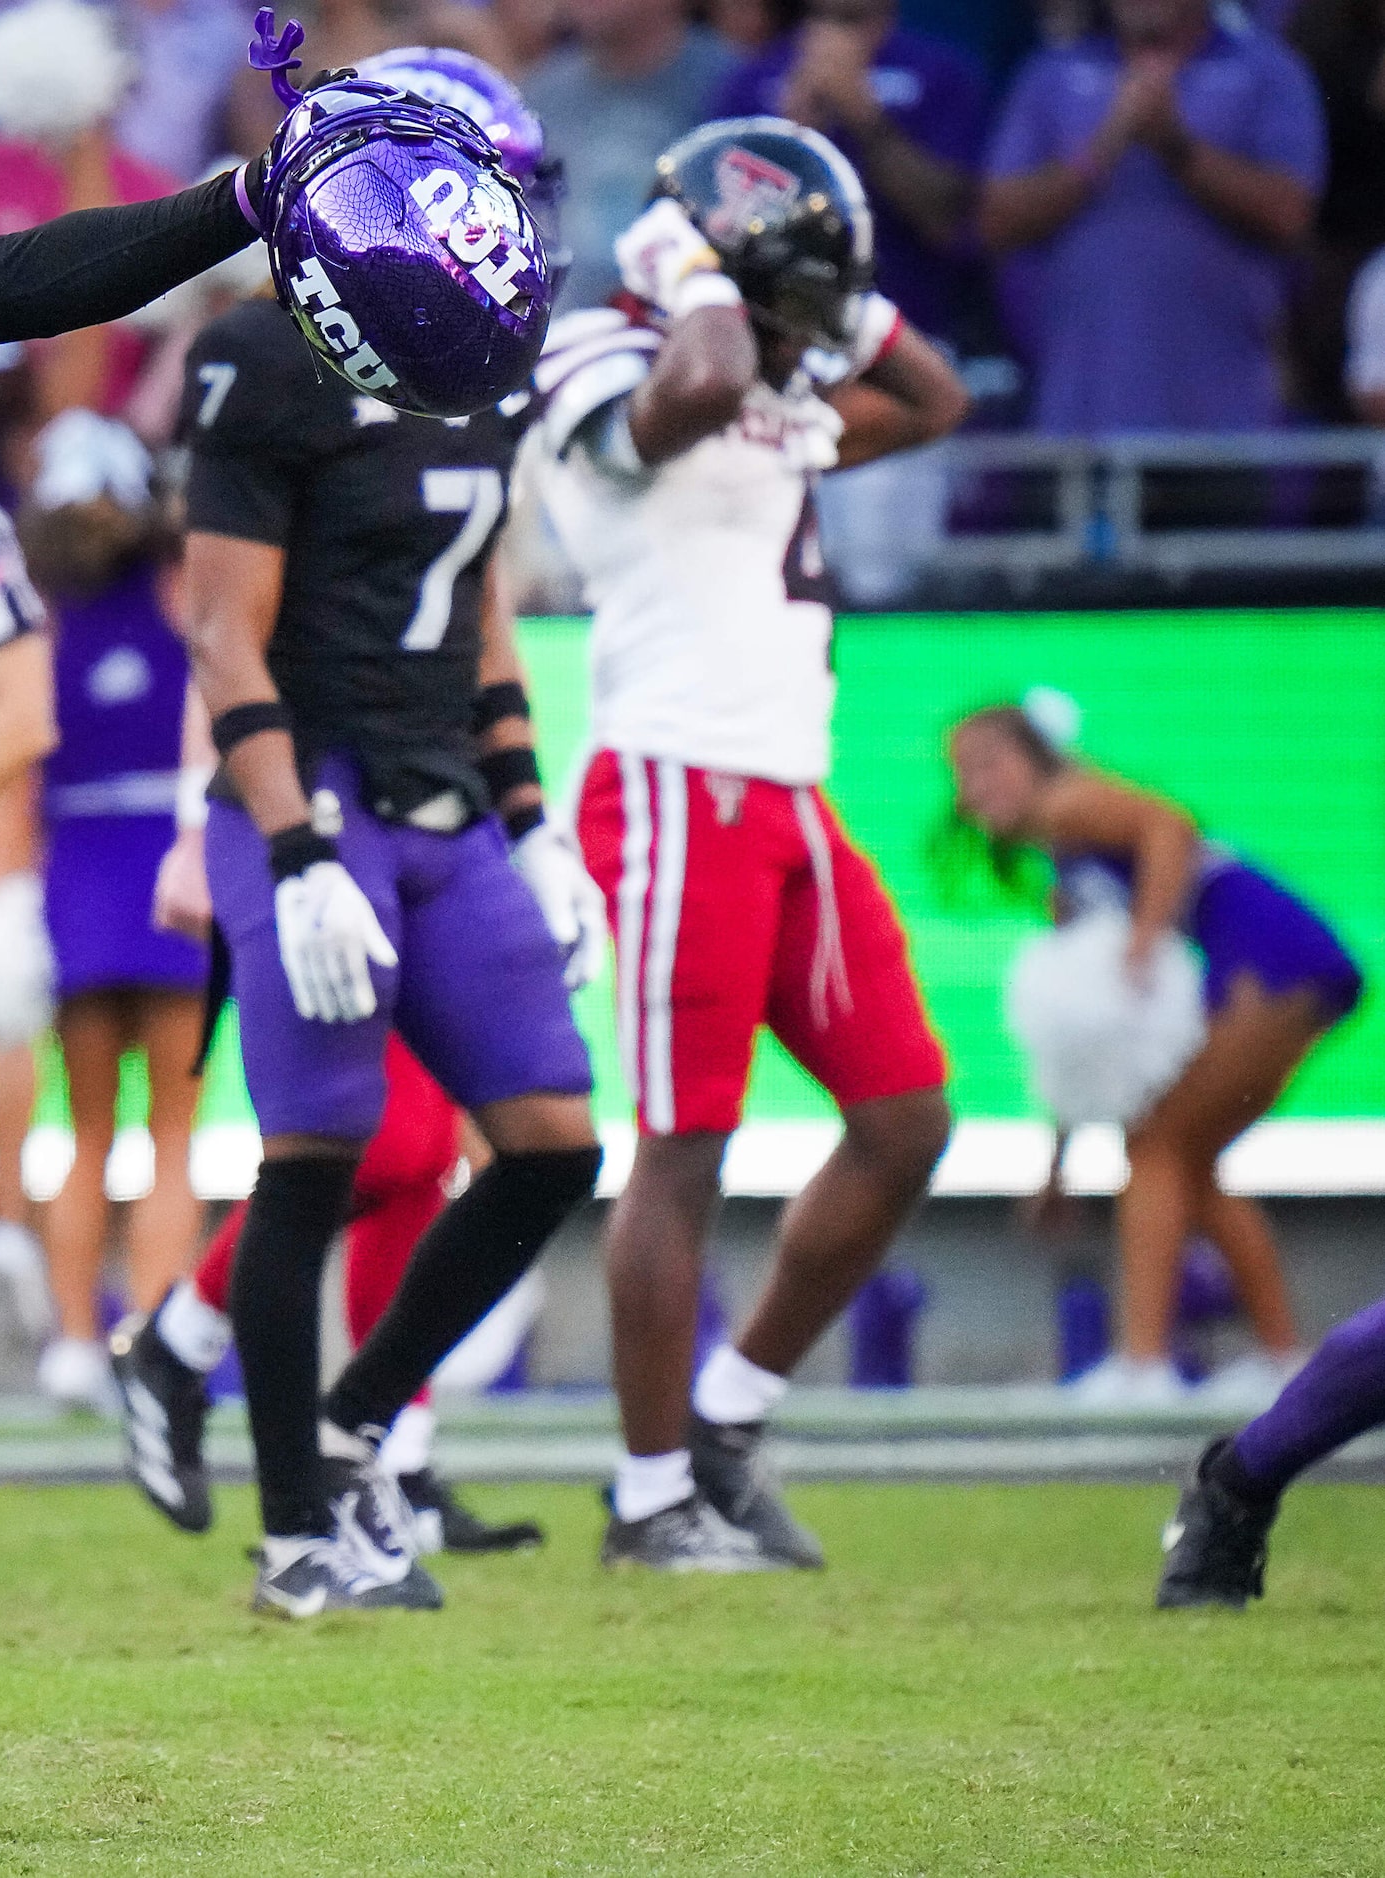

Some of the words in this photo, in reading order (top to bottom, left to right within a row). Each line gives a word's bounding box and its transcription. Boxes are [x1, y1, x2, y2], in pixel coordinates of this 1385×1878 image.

[408, 168, 531, 306] TCU
[290, 256, 399, 389] TCU
[197, 362, 238, 429] 7
[401, 467, 503, 651] 7
